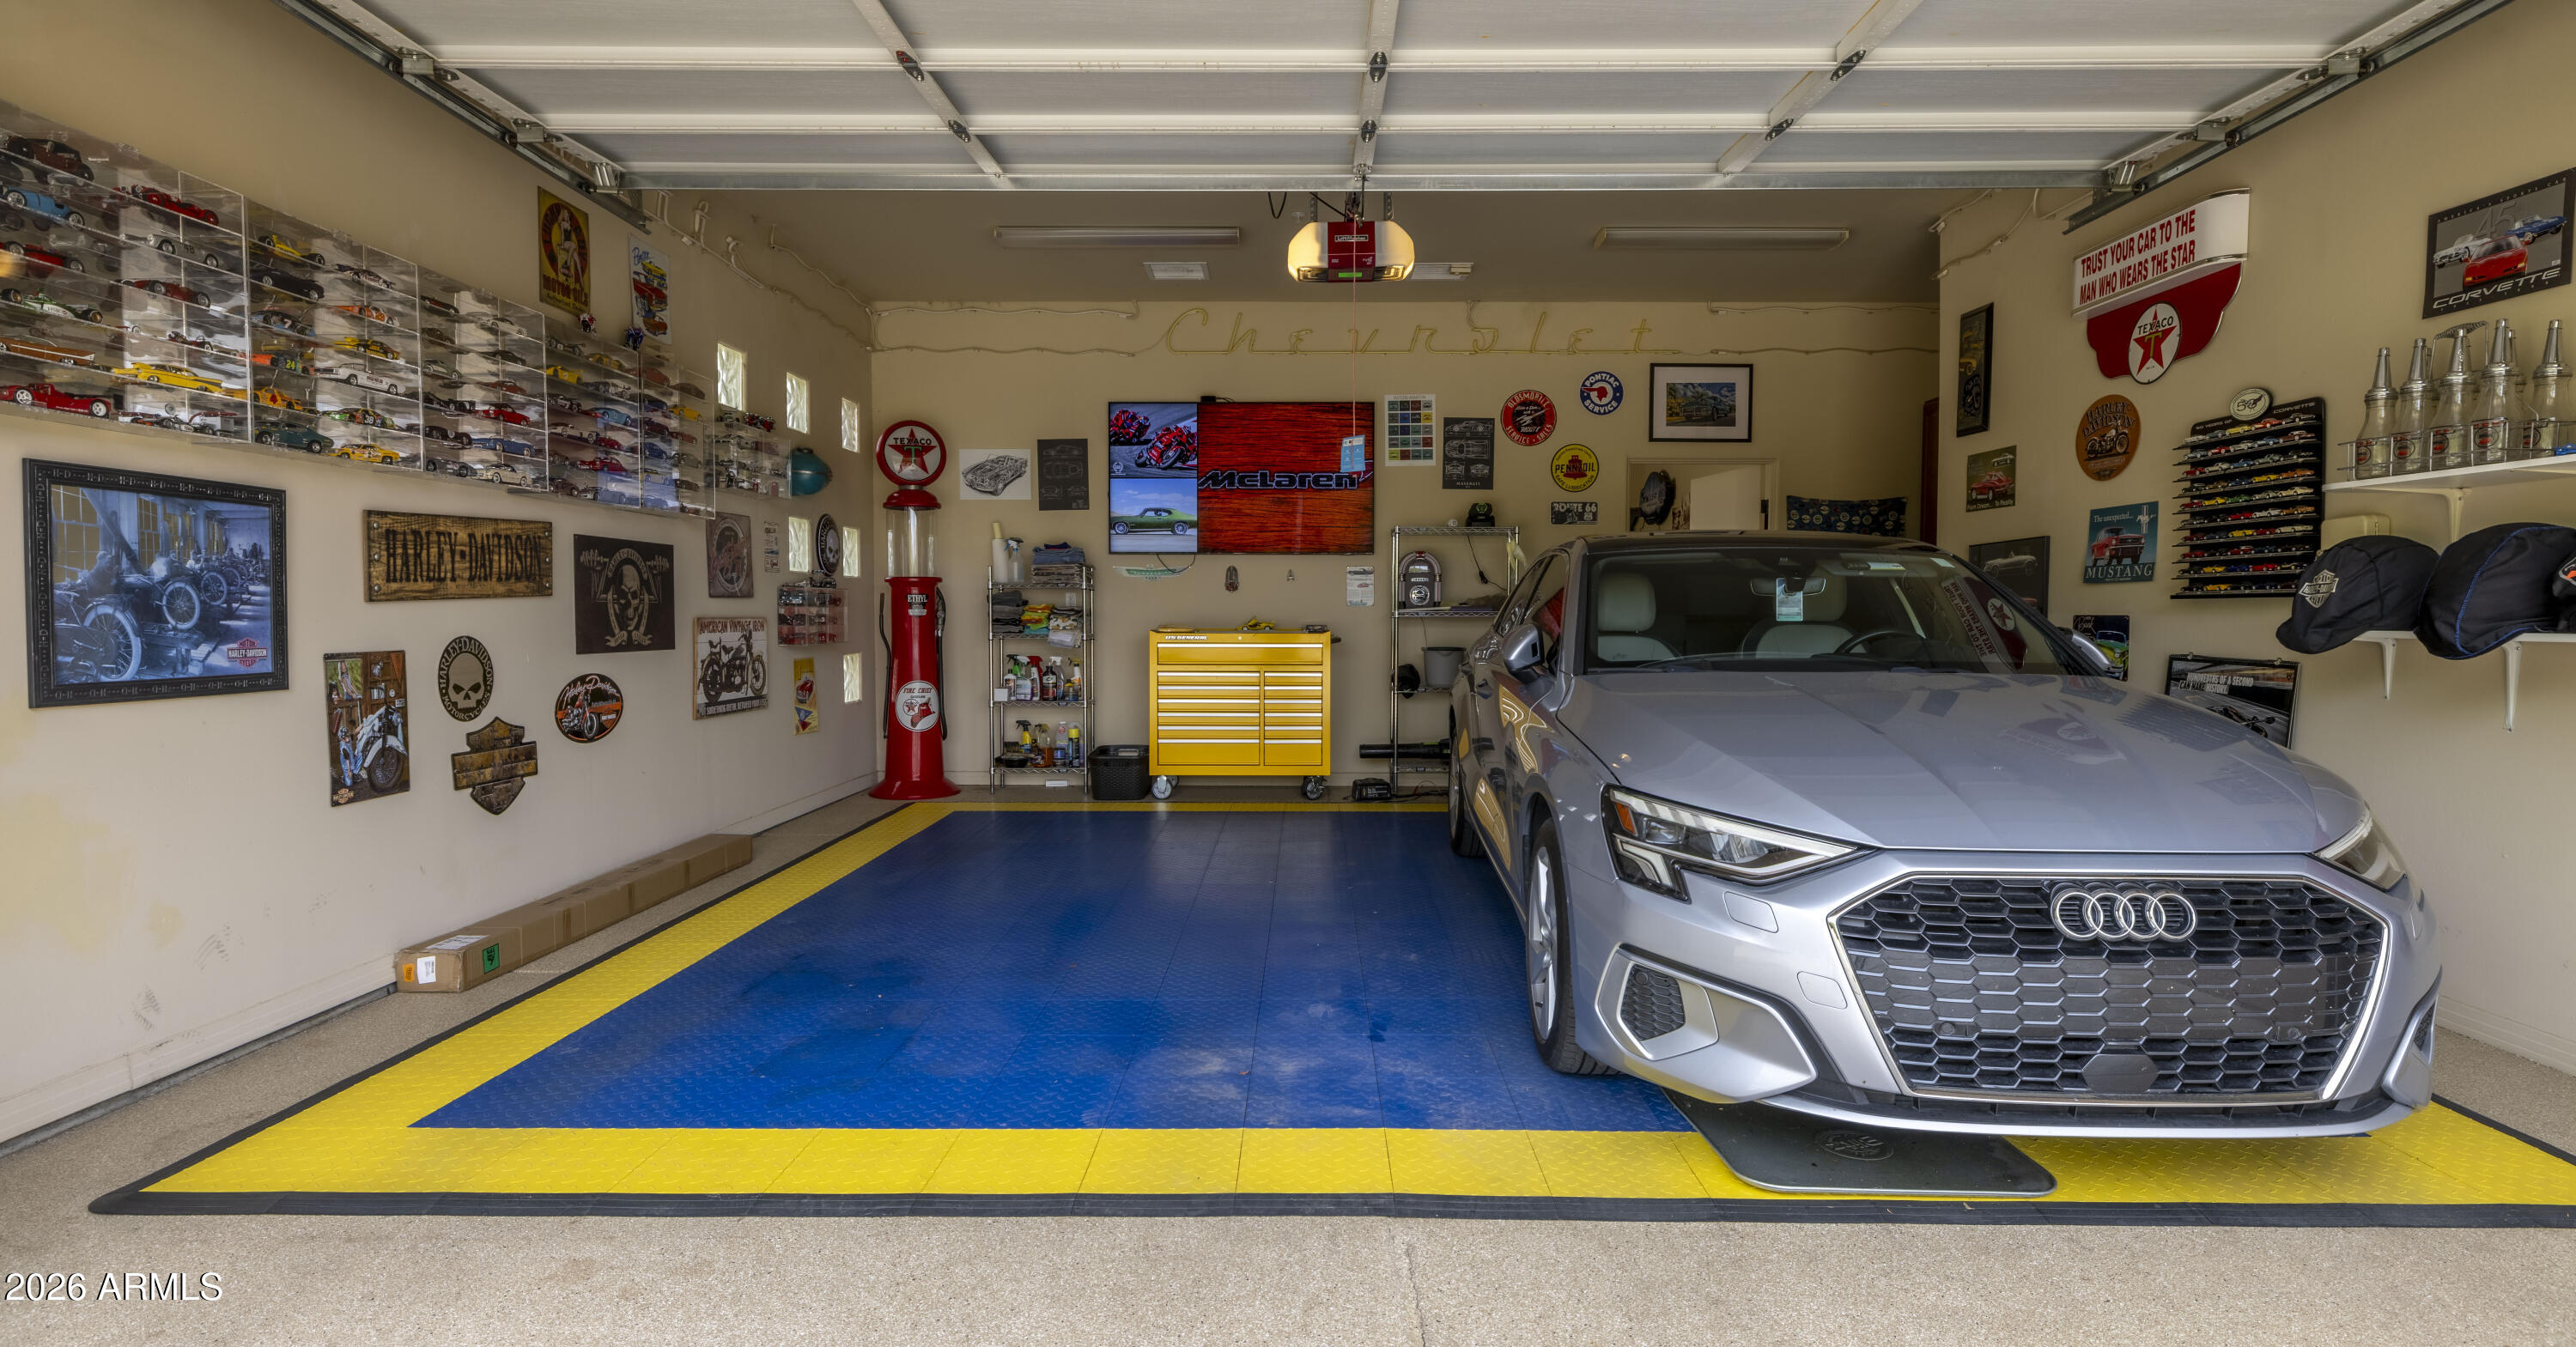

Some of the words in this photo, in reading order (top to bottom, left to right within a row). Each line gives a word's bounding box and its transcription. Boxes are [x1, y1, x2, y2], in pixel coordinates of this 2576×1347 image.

[2081, 249, 2108, 278] TRUST
[2111, 237, 2135, 266] YOUR
[2137, 228, 2156, 254] CAR
[2160, 220, 2172, 245] TO
[2175, 209, 2196, 238] THE
[2080, 280, 2097, 305] MAN
[2099, 271, 2117, 298] WHO
[2119, 258, 2148, 289] WEARS
[2151, 250, 2168, 277] THE
[2171, 240, 2195, 270] STAR
[2433, 268, 2561, 308] CORVETTE
[1167, 309, 1654, 354] Chevrolet
[2138, 316, 2173, 336] TEXACO
[286, 359, 295, 370] 24
[1585, 373, 1619, 387] PONTIAC
[1508, 391, 1549, 408] OLDSMOBILE
[1584, 400, 1618, 413] SERVICE
[2087, 402, 2129, 421] HARLEY
[2273, 402, 2316, 415] CORVETTE
[364, 414, 374, 424] 38
[2082, 414, 2136, 439] DAVIDSON
[893, 437, 932, 446] TEXACO
[1506, 425, 1529, 444] SERVICE
[1536, 424, 1552, 440] SALES
[1555, 463, 1595, 474] PENNZOIL
[1198, 470, 1358, 489] McLaren
[1585, 503, 1597, 512] 66
[2086, 564, 2153, 579] MUSTANG
[699, 620, 728, 634] AMERICAN
[729, 620, 751, 633] VINTAGE
[752, 620, 765, 633] IRON
[228, 648, 267, 658] HARLEY-DAVIDSON
[439, 637, 493, 687] HARLEY-DAVIDSON
[2187, 673, 2219, 684] HUNDREDTHS
[2219, 676, 2227, 684] OF
[2233, 677, 2253, 687] SECOND
[442, 692, 490, 720] MOTORCYCLES
